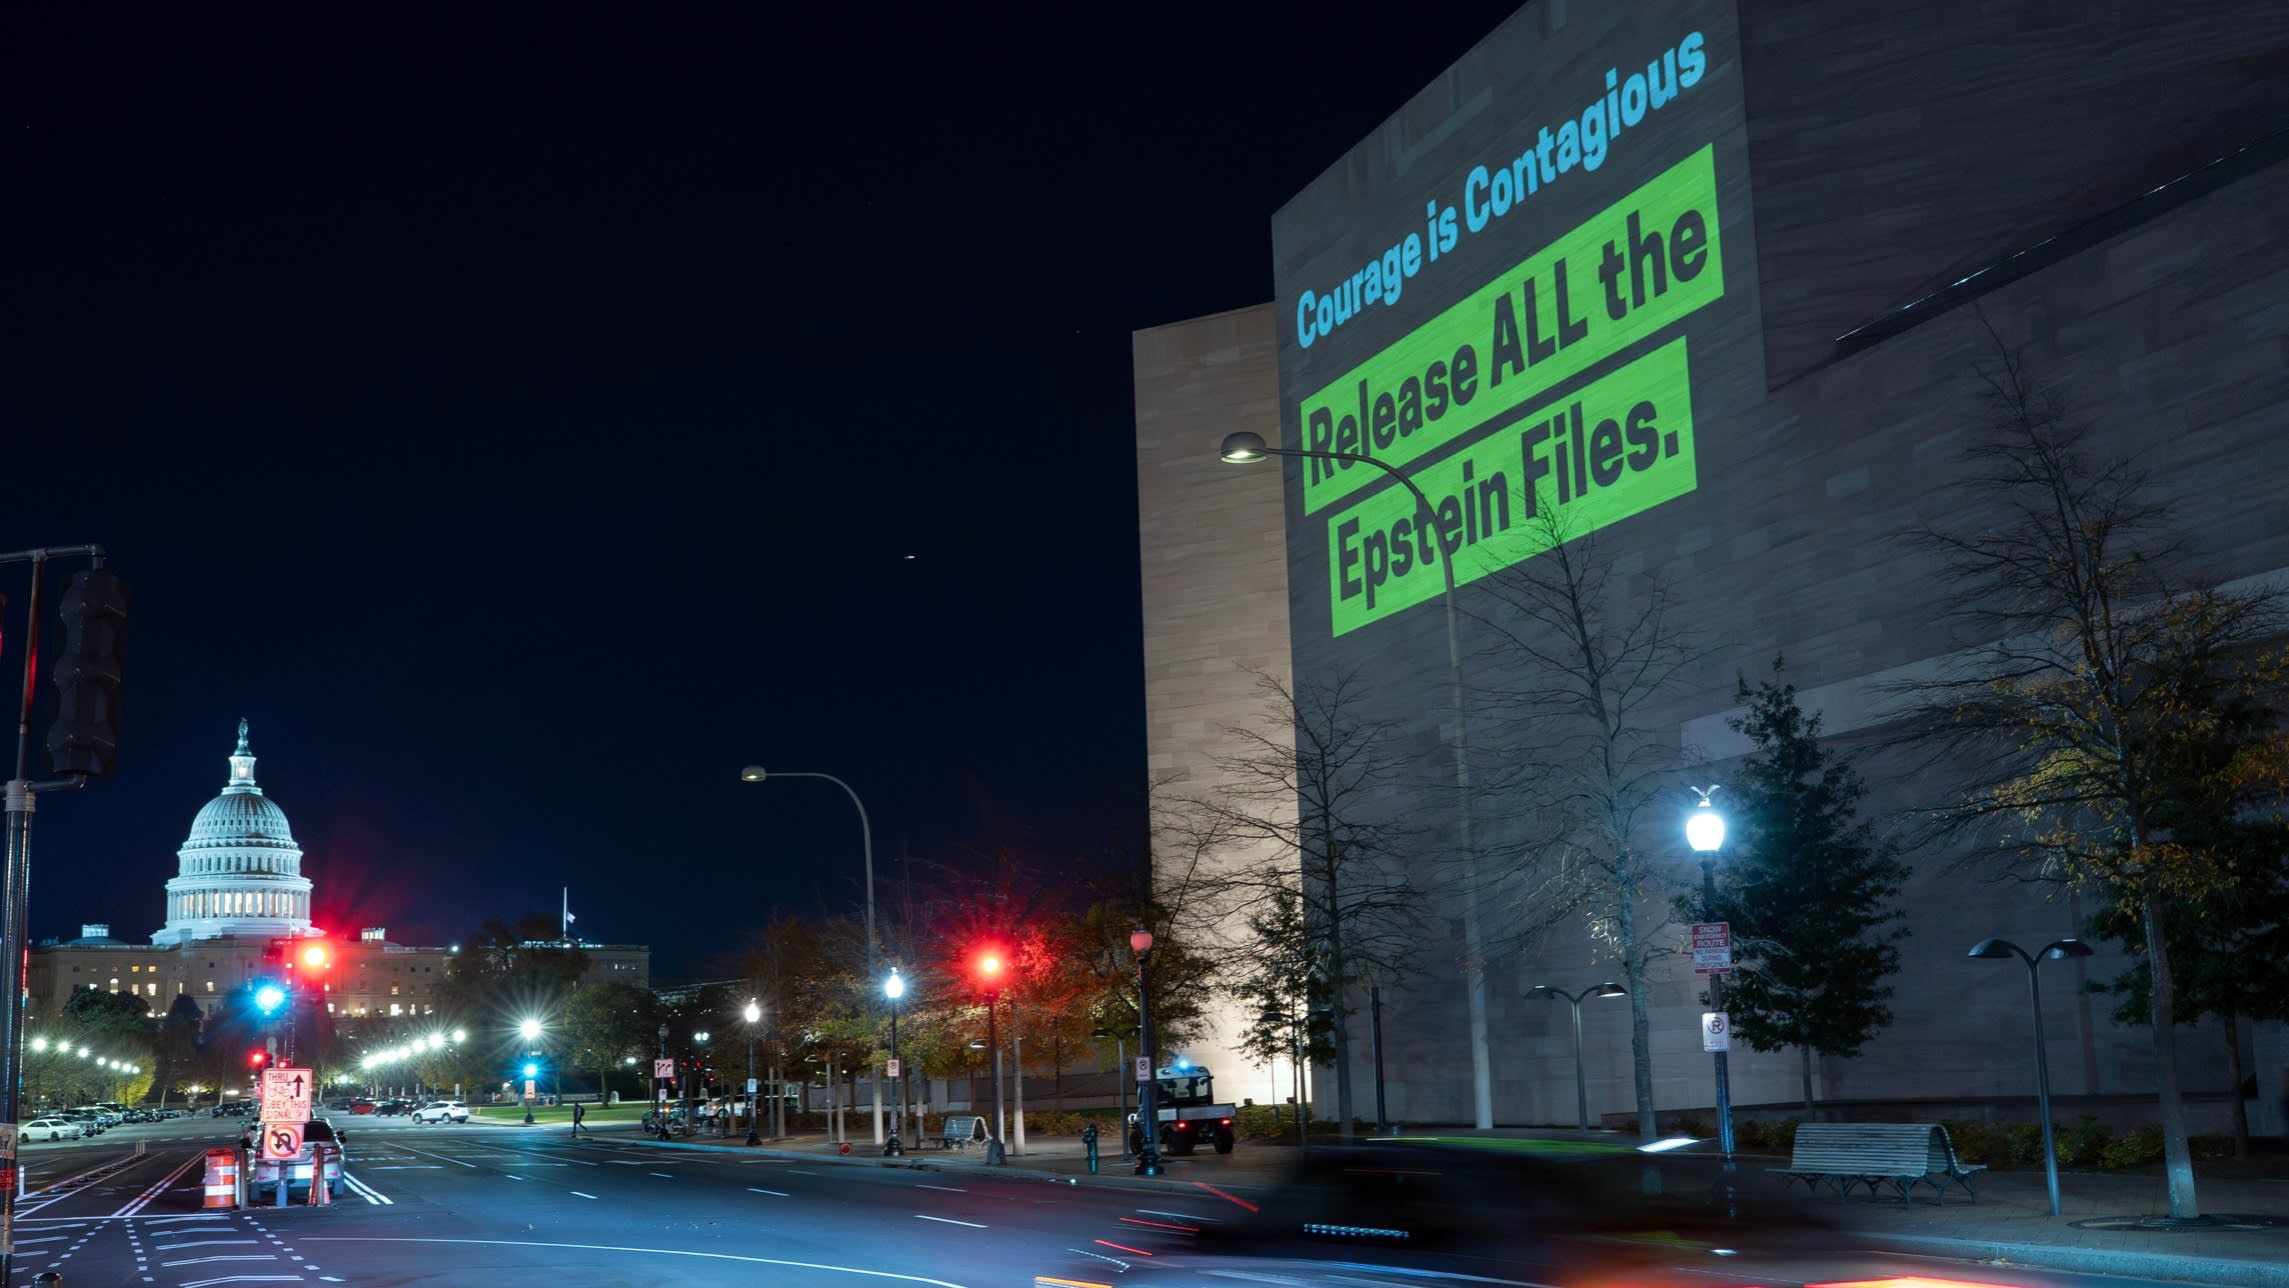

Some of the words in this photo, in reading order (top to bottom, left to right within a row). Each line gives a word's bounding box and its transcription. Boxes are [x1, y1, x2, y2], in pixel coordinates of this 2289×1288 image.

[1297, 233, 1421, 349] Courage
[1427, 200, 1458, 261] is
[1465, 32, 1706, 233] Contagious
[1308, 345, 1478, 487] Release
[1491, 258, 1588, 387] ALL
[1599, 210, 1707, 320] the
[1338, 459, 1510, 610] Epstein
[1522, 401, 1679, 520] Files.
[1697, 925, 1721, 935] SNOW
[1696, 939, 1726, 948] ROUTE
[268, 1072, 289, 1081] THRU
[290, 1099, 307, 1108] THIS
[265, 1110, 293, 1120] SIGNAL
